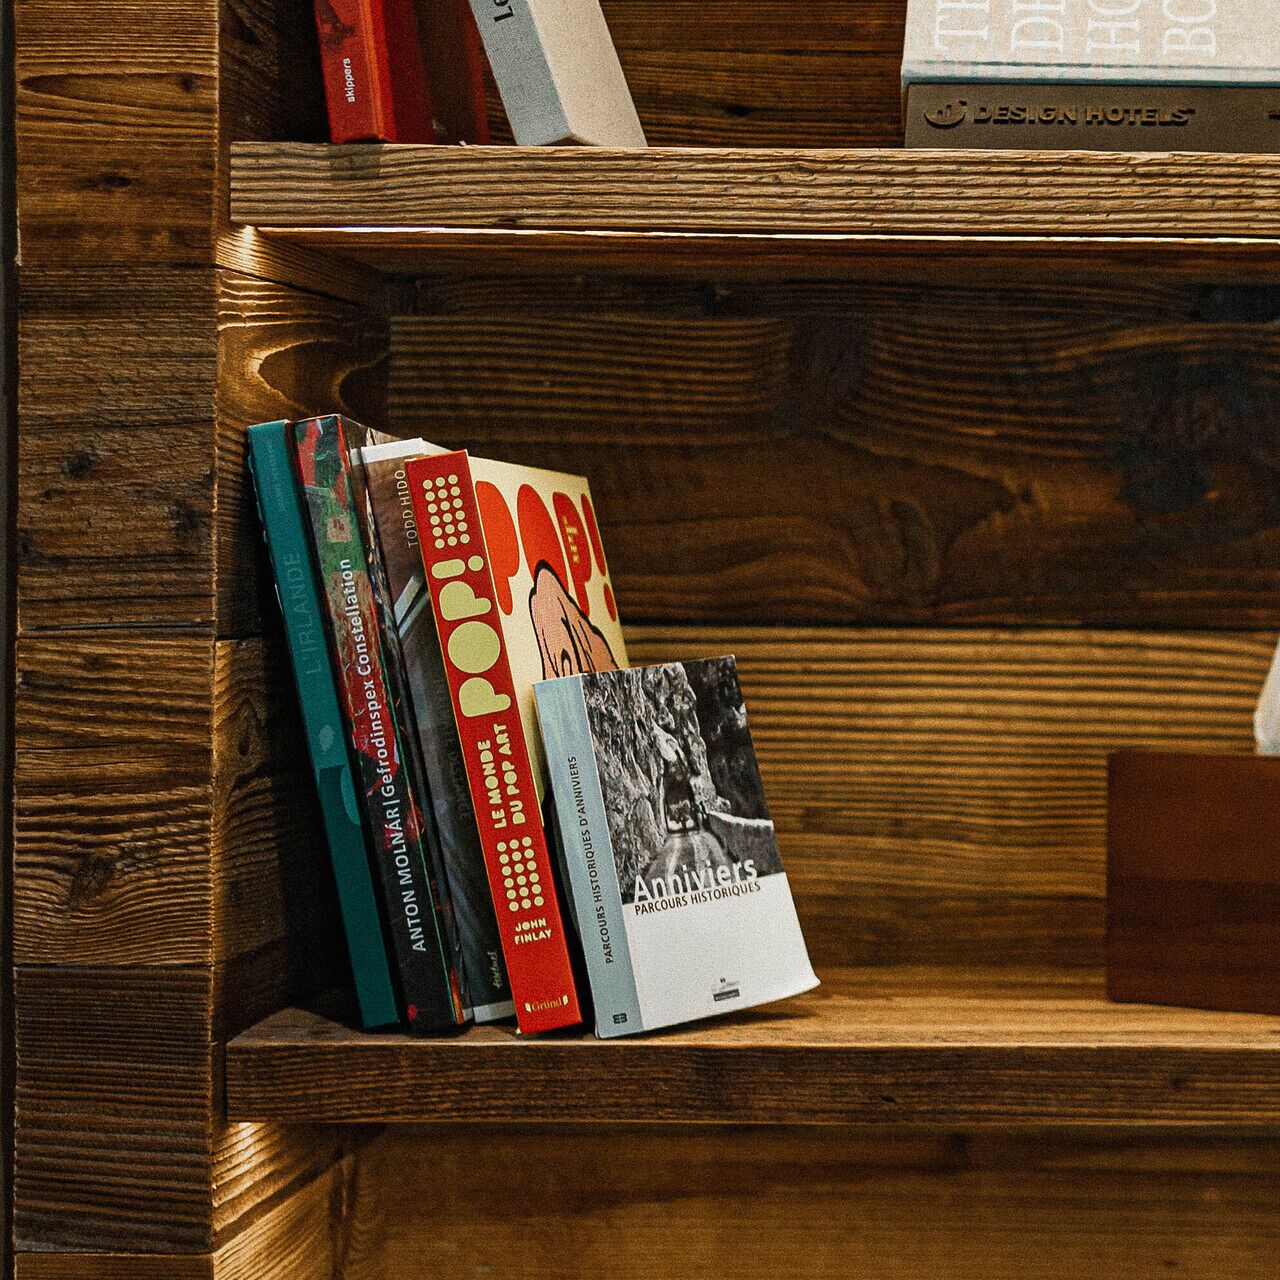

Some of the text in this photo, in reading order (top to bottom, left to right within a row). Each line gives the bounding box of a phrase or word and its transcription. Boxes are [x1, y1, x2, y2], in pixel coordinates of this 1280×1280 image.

[342, 56, 356, 103] skippers
[974, 105, 1188, 126] DESIGN HOTELS
[394, 469, 418, 548] TODD HIDO
[431, 555, 512, 717] POP!
[340, 559, 427, 952] ANTON MOLNÁR Gefrodinspex Constellation
[478, 739, 508, 829] LE MONDE
[493, 723, 526, 825] DU POP ART
[567, 756, 612, 964] PARCOURS HISTORIQUES D'ANNIVIERS
[634, 859, 758, 903] Anniviers
[515, 917, 547, 932] JOHN
[634, 881, 761, 916] PARCOURS HISTORIQUES
[514, 929, 552, 945] FINLAY
